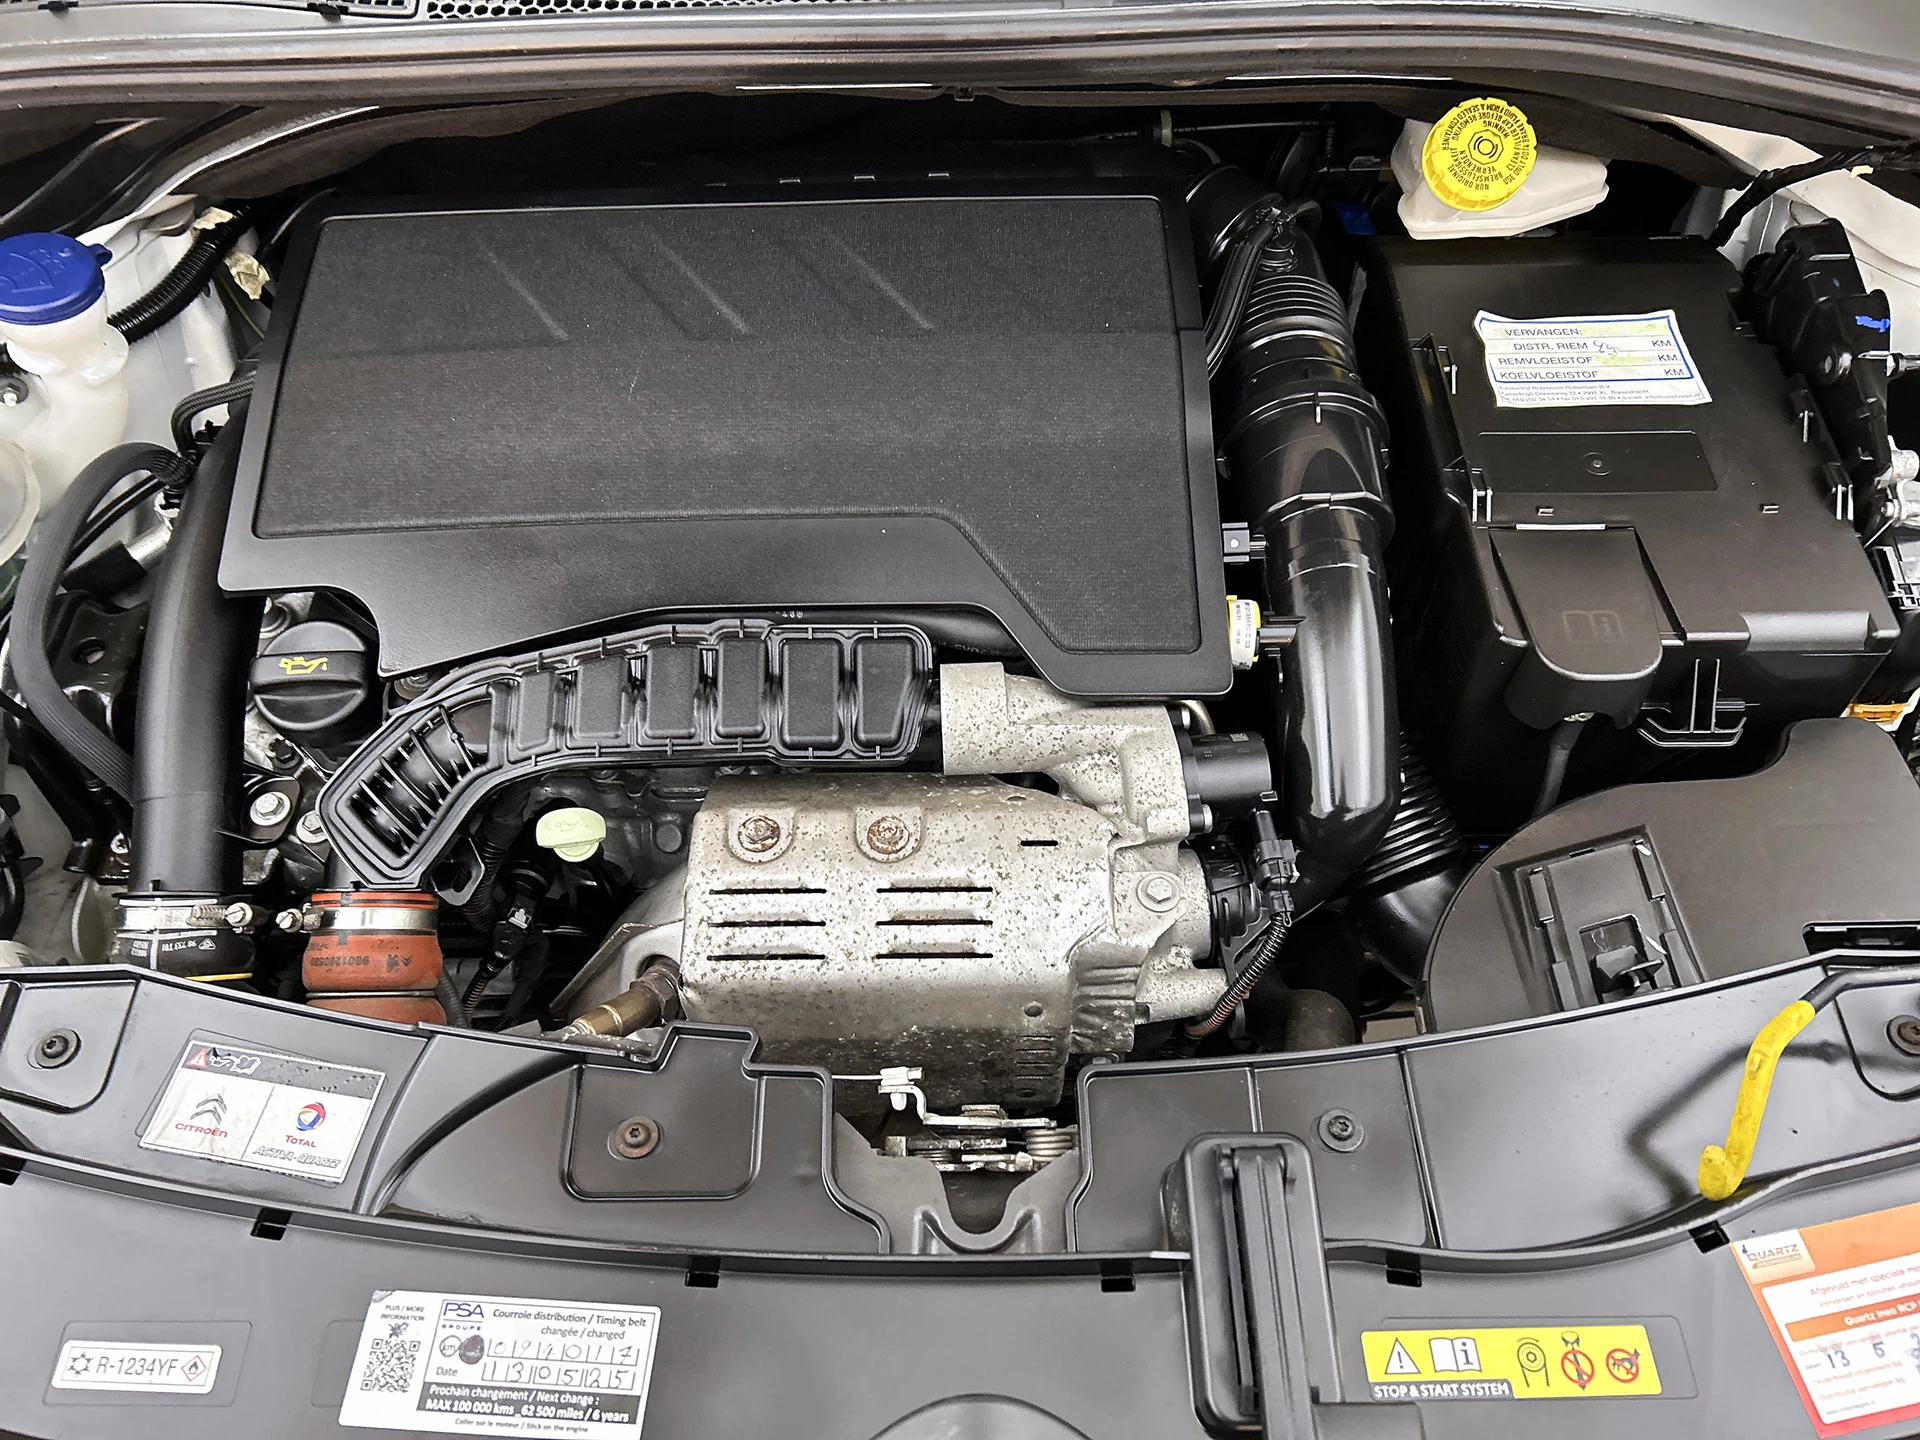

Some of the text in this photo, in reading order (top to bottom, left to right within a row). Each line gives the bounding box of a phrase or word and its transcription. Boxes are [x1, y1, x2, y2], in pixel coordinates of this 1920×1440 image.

[1457, 104, 1479, 120] SEALED
[1442, 117, 1459, 151] CONTAINER
[1483, 120, 1510, 139] WARNING
[1452, 112, 1521, 171] CLEAN FILLER CAP BEFORE REMOVING
[1459, 150, 1496, 174] VERWENDEN
[1514, 160, 1526, 175] ONLY
[1447, 164, 1489, 191] NUR ORIGINAL
[1503, 174, 1514, 185] USE
[1505, 328, 1583, 336] VERVANGEN:
[1513, 342, 1554, 350] DISTR.
[1498, 356, 1593, 365] REMVLOEISTOF
[1500, 371, 1598, 379] KOELVLOEISTOF
[285, 1135, 317, 1148] TOTAL
[1746, 1244, 1799, 1261] QUARTZ
[380, 1313, 425, 1321] INFORMATION
[443, 1302, 485, 1318] PSA
[493, 1308, 647, 1327] Courroie distribution / Timing belt
[541, 1326, 625, 1340] changée / changed
[95, 1356, 179, 1376] R-1234YF
[436, 1366, 458, 1376] Date
[429, 1384, 470, 1398] Prochain
[471, 1387, 529, 1401] changement
[528, 1390, 536, 1402] /
[537, 1390, 559, 1403] Next
[560, 1393, 594, 1406] change
[1373, 1382, 1510, 1398] STOP & START SYSTEM
[425, 1398, 452, 1411] MAX
[452, 1399, 472, 1412] 100
[472, 1401, 492, 1414] 000
[535, 1405, 556, 1417] 500
[556, 1407, 584, 1420] miles
[592, 1408, 600, 1421] 6
[601, 1411, 630, 1423] years
